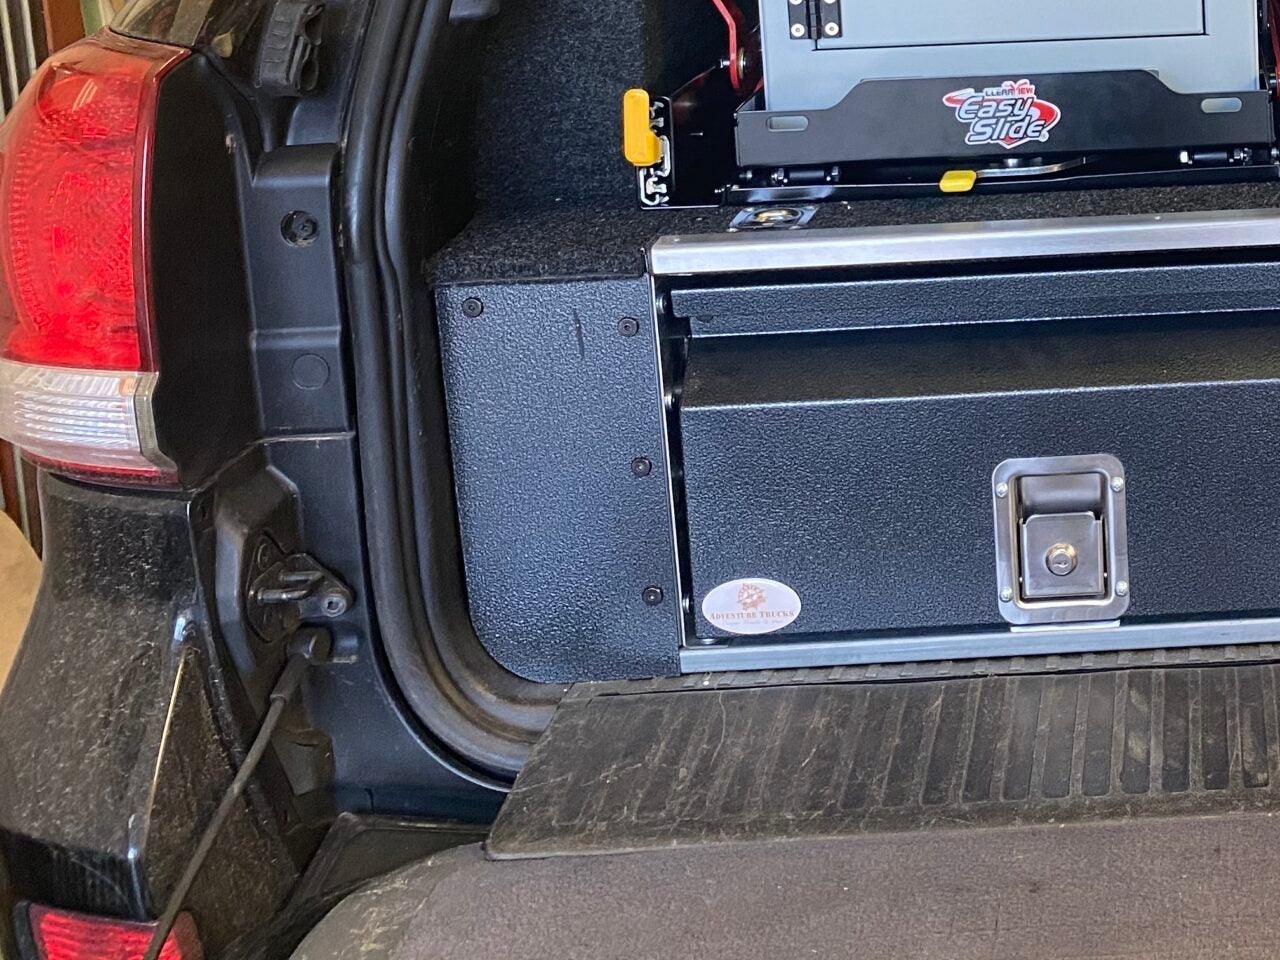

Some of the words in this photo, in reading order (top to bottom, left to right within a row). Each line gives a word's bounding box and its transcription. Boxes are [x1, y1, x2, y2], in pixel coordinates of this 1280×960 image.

[959, 96, 1034, 120] Easy
[967, 116, 1046, 141] Slide
[760, 610, 795, 618] TRUCKS
